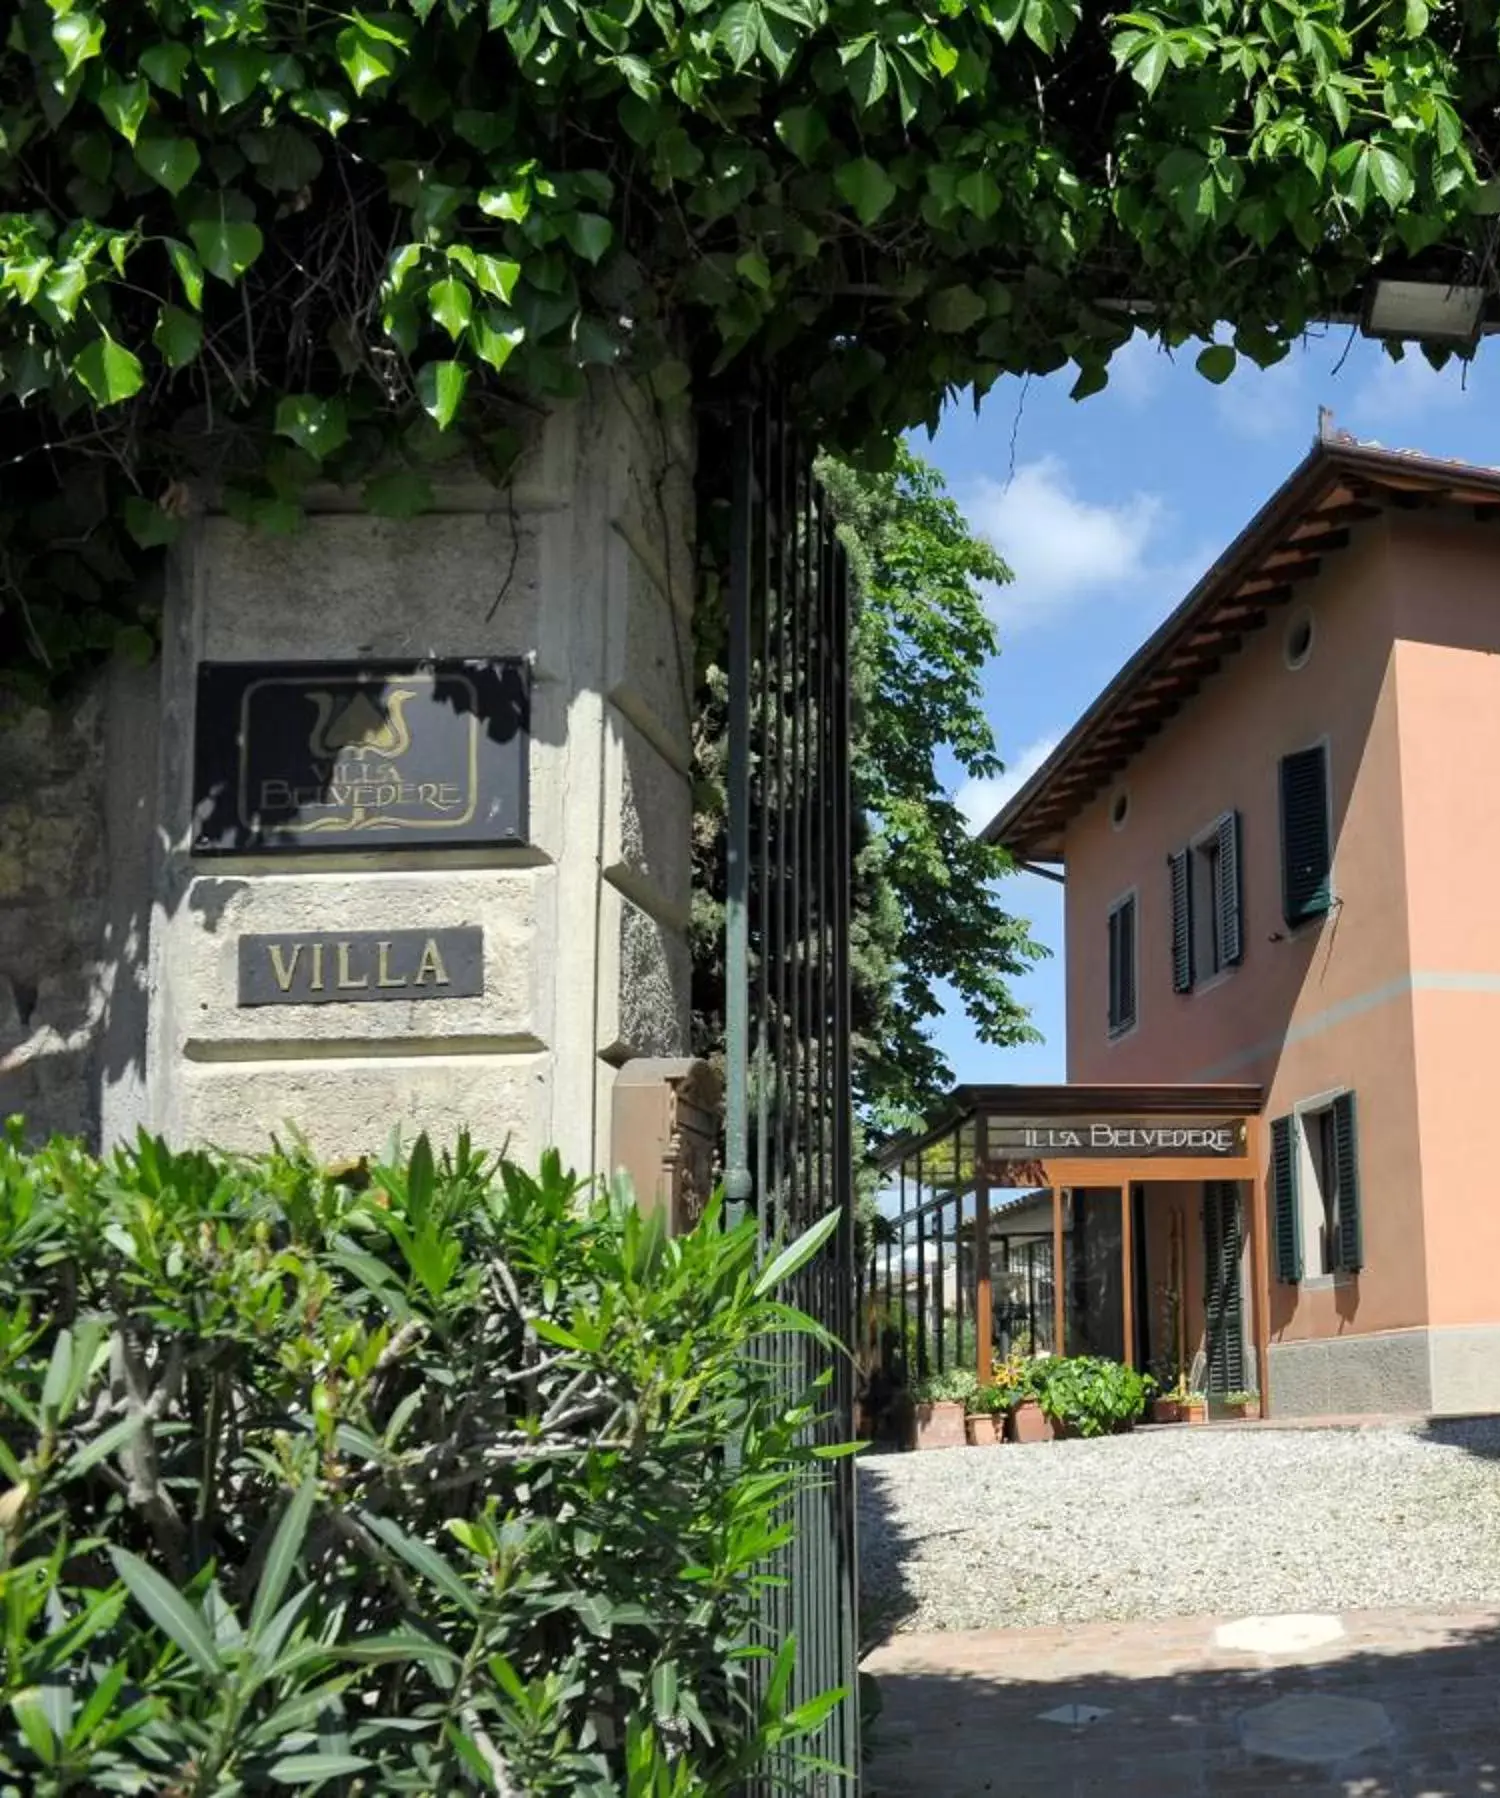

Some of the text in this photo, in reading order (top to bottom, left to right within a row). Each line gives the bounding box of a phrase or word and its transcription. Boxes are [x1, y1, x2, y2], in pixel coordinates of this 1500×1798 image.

[309, 763, 406, 785] VILLA
[260, 779, 462, 812] BELVEDERE
[267, 937, 451, 993] VILLA
[1018, 1122, 1233, 1151] ILLA BELVEDERE
